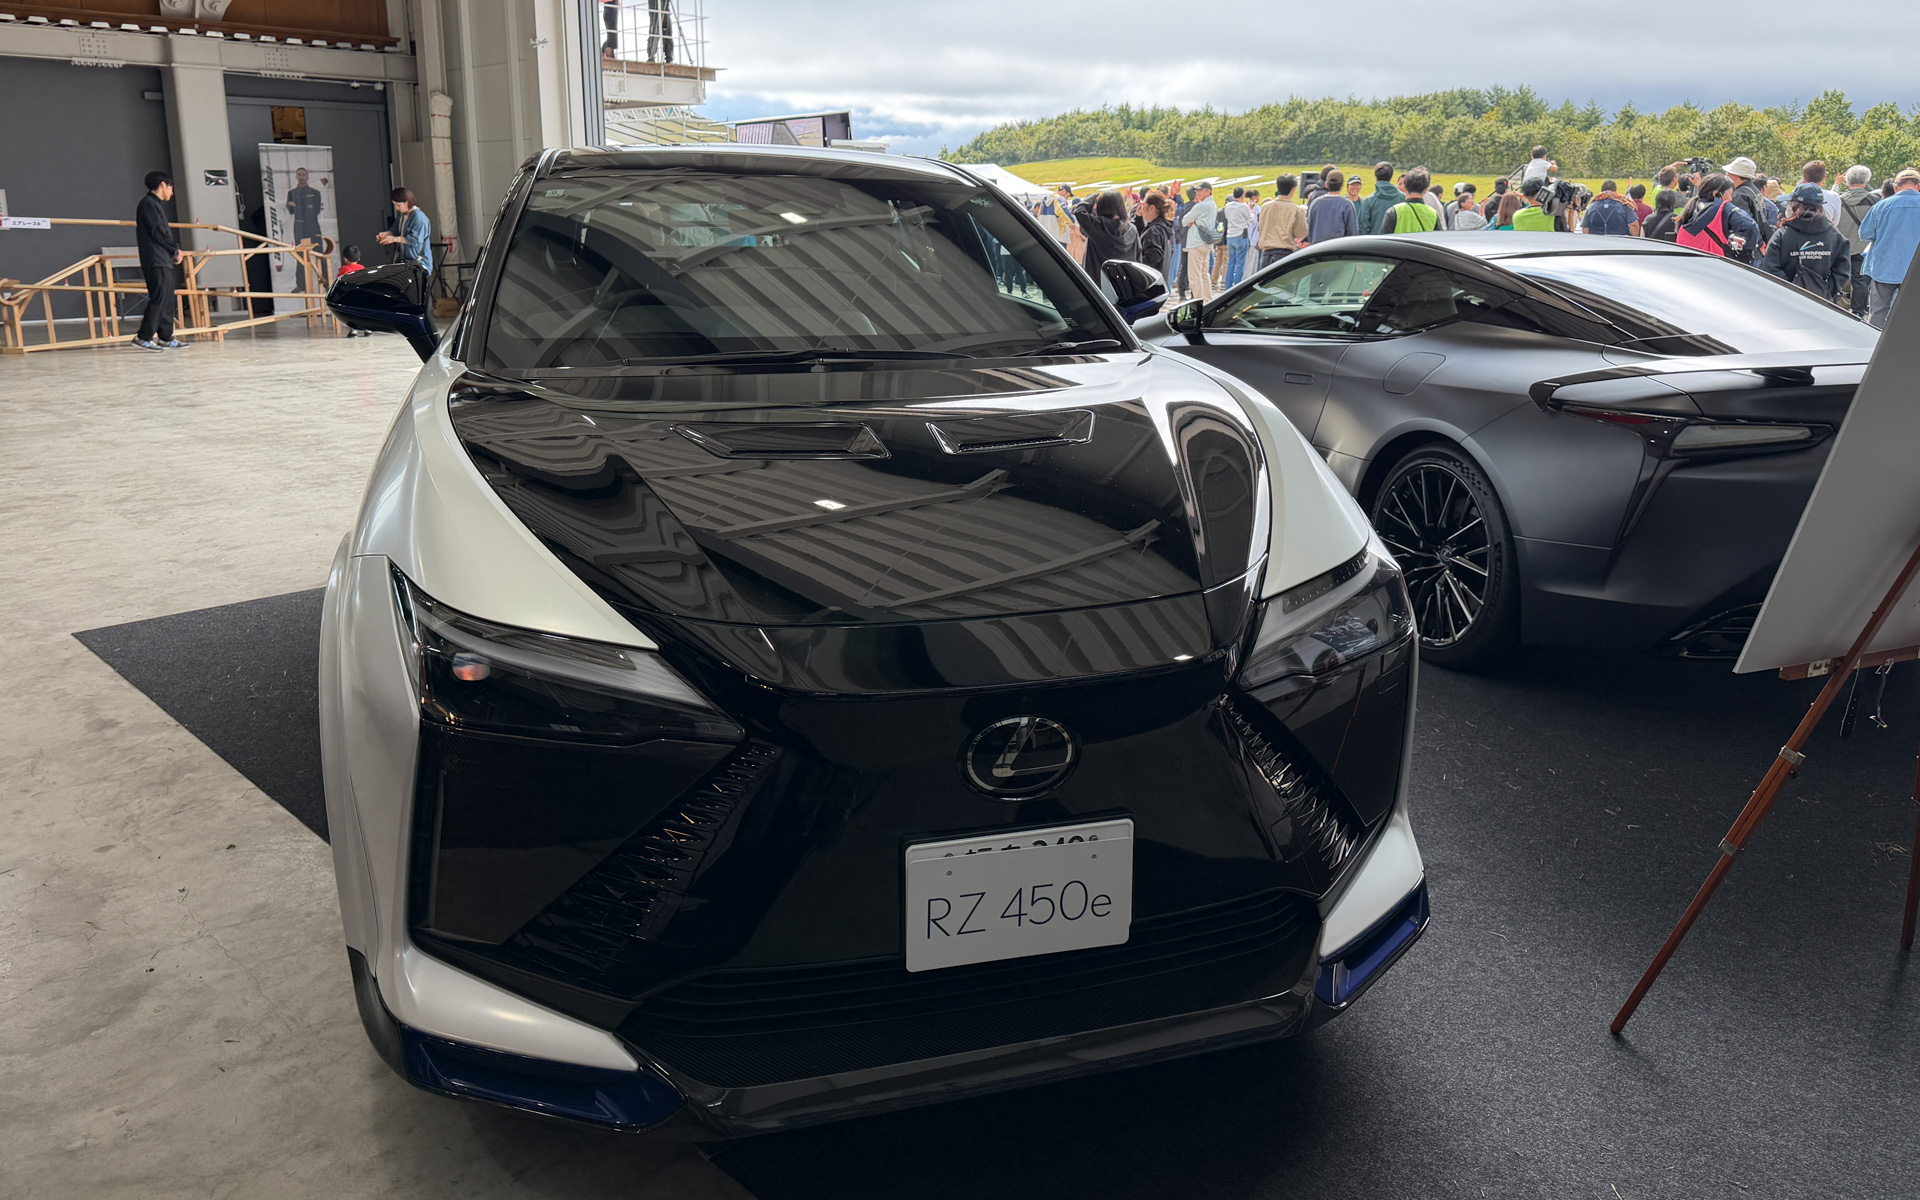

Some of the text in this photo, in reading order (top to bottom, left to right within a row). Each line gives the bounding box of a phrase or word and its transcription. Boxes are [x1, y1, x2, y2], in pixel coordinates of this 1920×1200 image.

[1486, 560, 1502, 618] MICHELIN
[926, 879, 1112, 940] RZ 450e
